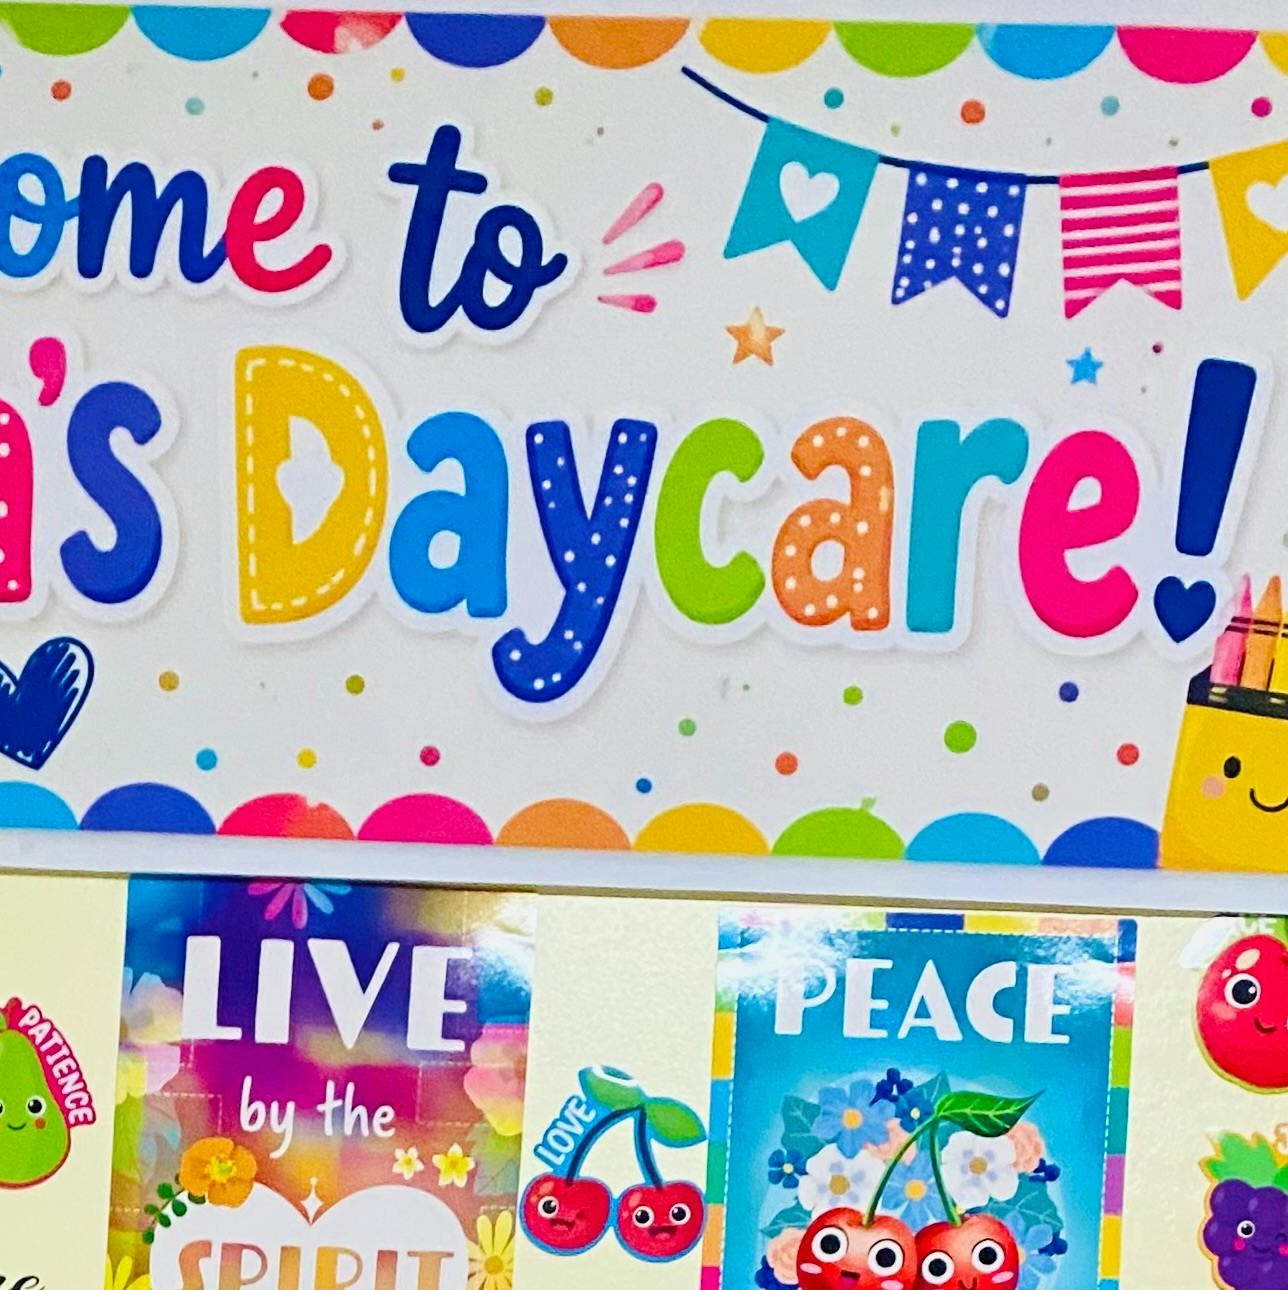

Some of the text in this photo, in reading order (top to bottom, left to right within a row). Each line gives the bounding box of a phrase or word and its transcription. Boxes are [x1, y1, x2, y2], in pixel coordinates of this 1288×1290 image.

[388, 125, 568, 333] to
[235, 344, 1258, 703] Daycare!
[181, 935, 474, 1053] LIVE
[772, 955, 1073, 1047] PEACE
[20, 1006, 95, 1125] PATIENCE
[239, 1075, 396, 1160] by the
[537, 1099, 596, 1166] LOVE
